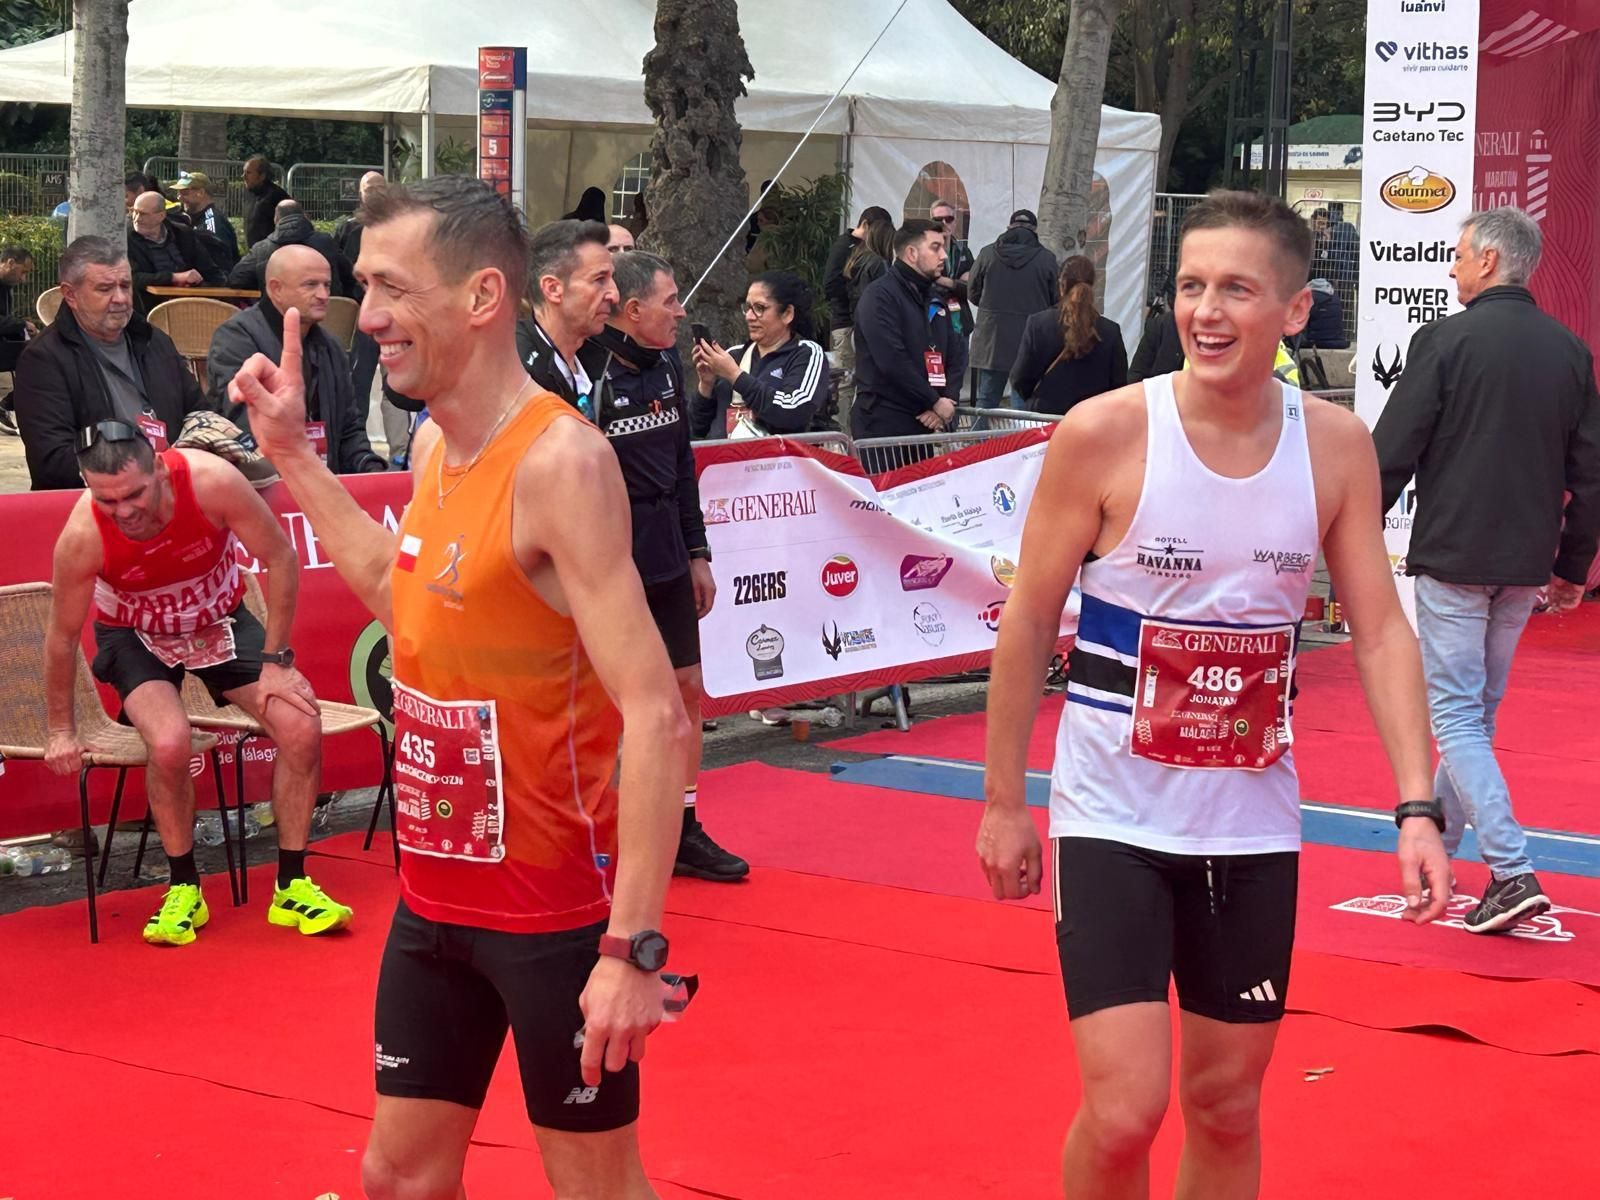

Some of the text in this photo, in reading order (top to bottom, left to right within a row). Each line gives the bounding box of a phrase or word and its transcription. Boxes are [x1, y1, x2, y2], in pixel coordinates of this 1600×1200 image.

[1404, 42, 1469, 60] vithas
[1372, 102, 1466, 122] BYD
[1372, 129, 1465, 143] Caetano Tec
[488, 139, 497, 155] 5
[1388, 184, 1448, 198] Gourmet
[1375, 287, 1449, 306] POWER
[731, 489, 817, 522] GENERALI
[1136, 552, 1203, 572] HAVANNA
[733, 570, 787, 606] 226ERS
[823, 570, 857, 587] Juver
[1184, 633, 1278, 654] GENERALI
[1186, 665, 1244, 692] 486
[400, 693, 466, 730] GENERALI
[400, 731, 437, 769] 435
[487, 802, 500, 834] BOX 2
